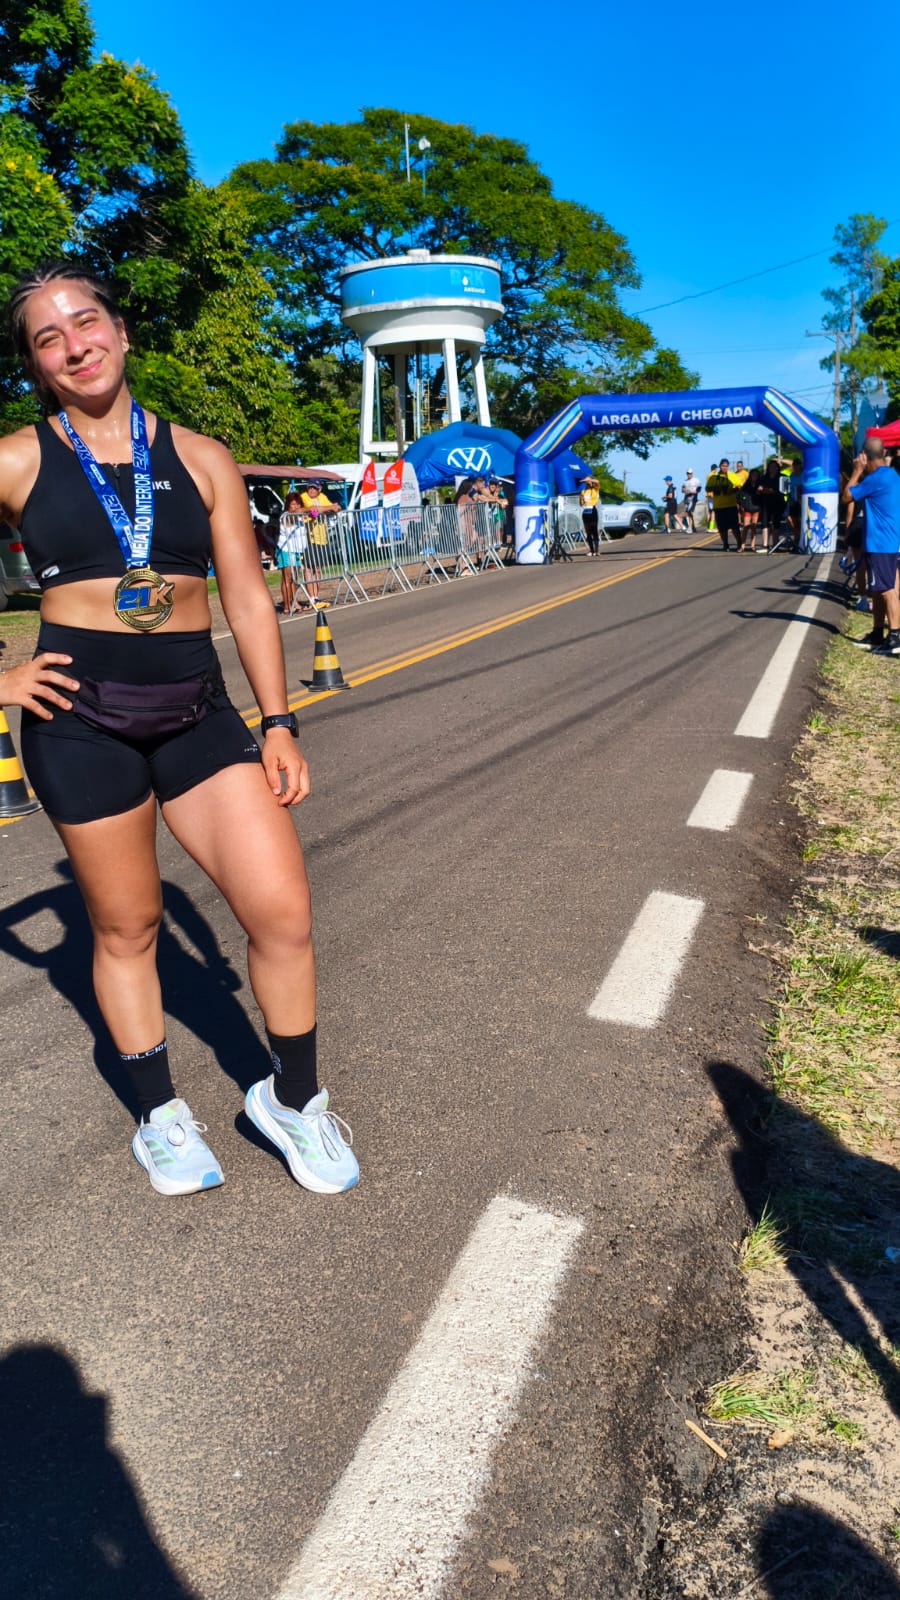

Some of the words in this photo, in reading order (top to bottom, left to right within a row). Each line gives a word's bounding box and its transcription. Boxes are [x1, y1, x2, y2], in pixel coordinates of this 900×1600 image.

[592, 412, 660, 426] LARGADA
[668, 411, 673, 422] /
[681, 406, 754, 421] CHEGADA
[132, 440, 147, 471] 21K
[134, 473, 152, 515] INTERIOR
[152, 480, 172, 490] IKE
[102, 494, 129, 523] 21K
[138, 516, 152, 532] DO
[131, 533, 149, 558] MEIA
[116, 582, 175, 611] 21K
